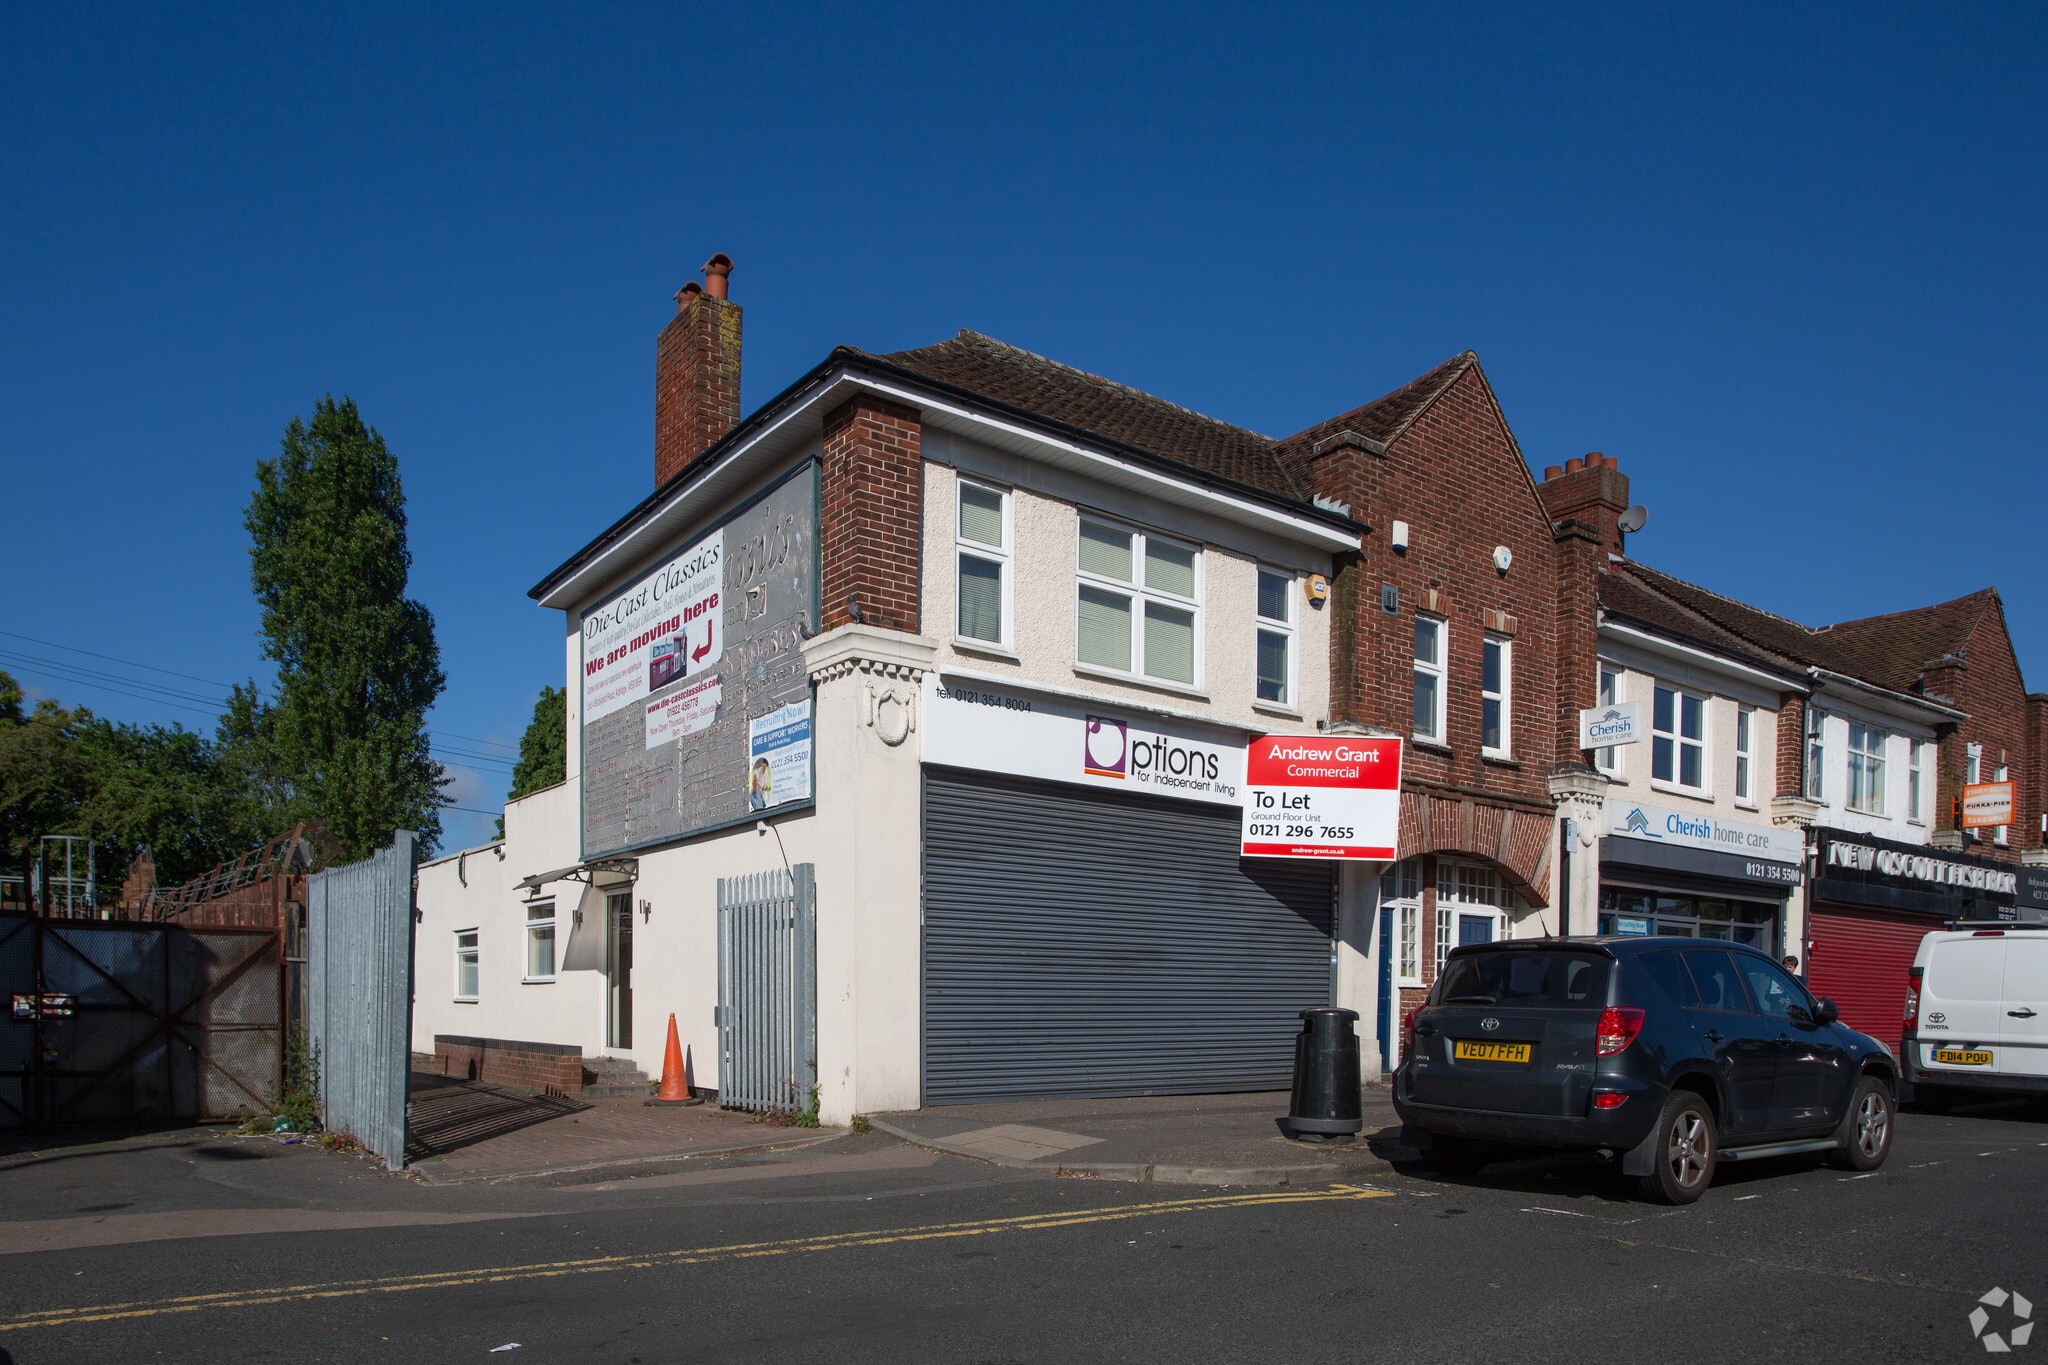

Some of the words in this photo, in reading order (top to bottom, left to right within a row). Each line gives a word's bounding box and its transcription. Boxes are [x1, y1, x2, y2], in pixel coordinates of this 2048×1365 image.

[586, 586, 648, 640] Die-Cast
[653, 544, 720, 601] Classics
[586, 658, 604, 676] We
[606, 645, 627, 666] are
[630, 614, 680, 653] moving
[684, 593, 719, 624] here
[956, 690, 978, 704] 0121
[982, 694, 1002, 708] 354
[1005, 697, 1031, 713] 8004
[755, 709, 785, 732] Recruiting
[787, 701, 805, 719] Now!
[753, 735, 763, 746] CARE
[767, 728, 786, 741] SUPPORT
[787, 720, 807, 734] WORKERS
[1590, 720, 1630, 737] Cherish
[1592, 735, 1613, 743] home
[783, 754, 792, 764] 354
[794, 749, 808, 762] 5500
[1268, 744, 1332, 762] Andrew
[1335, 746, 1380, 762] Grant
[1287, 765, 1359, 778] Commercial
[1138, 770, 1150, 782] for
[1155, 773, 1210, 792] independent
[1214, 782, 1236, 798] living
[1253, 791, 1274, 809] To
[1282, 792, 1310, 810] Let
[1251, 812, 1280, 821] Ground
[1282, 812, 1302, 822] Floor
[1305, 814, 1320, 822] Unit
[1250, 824, 1280, 836] 0121
[1286, 825, 1314, 838] 296
[1320, 826, 1354, 839] 7655
[1667, 814, 1710, 838] Cherish
[1714, 821, 1744, 844] home
[1746, 832, 1769, 848] care
[1746, 862, 1764, 878] 0121
[1767, 865, 1780, 880] 354
[1782, 867, 1800, 882] 5500
[1827, 840, 1877, 871] NEW
[1876, 850, 1949, 882] OSCOTT
[1985, 870, 2018, 895] BAR
[1462, 1043, 1496, 1057] VE07
[1498, 1044, 1525, 1060] FFH
[1940, 1052, 1962, 1060] FD14
[1966, 1053, 1988, 1062] POU
